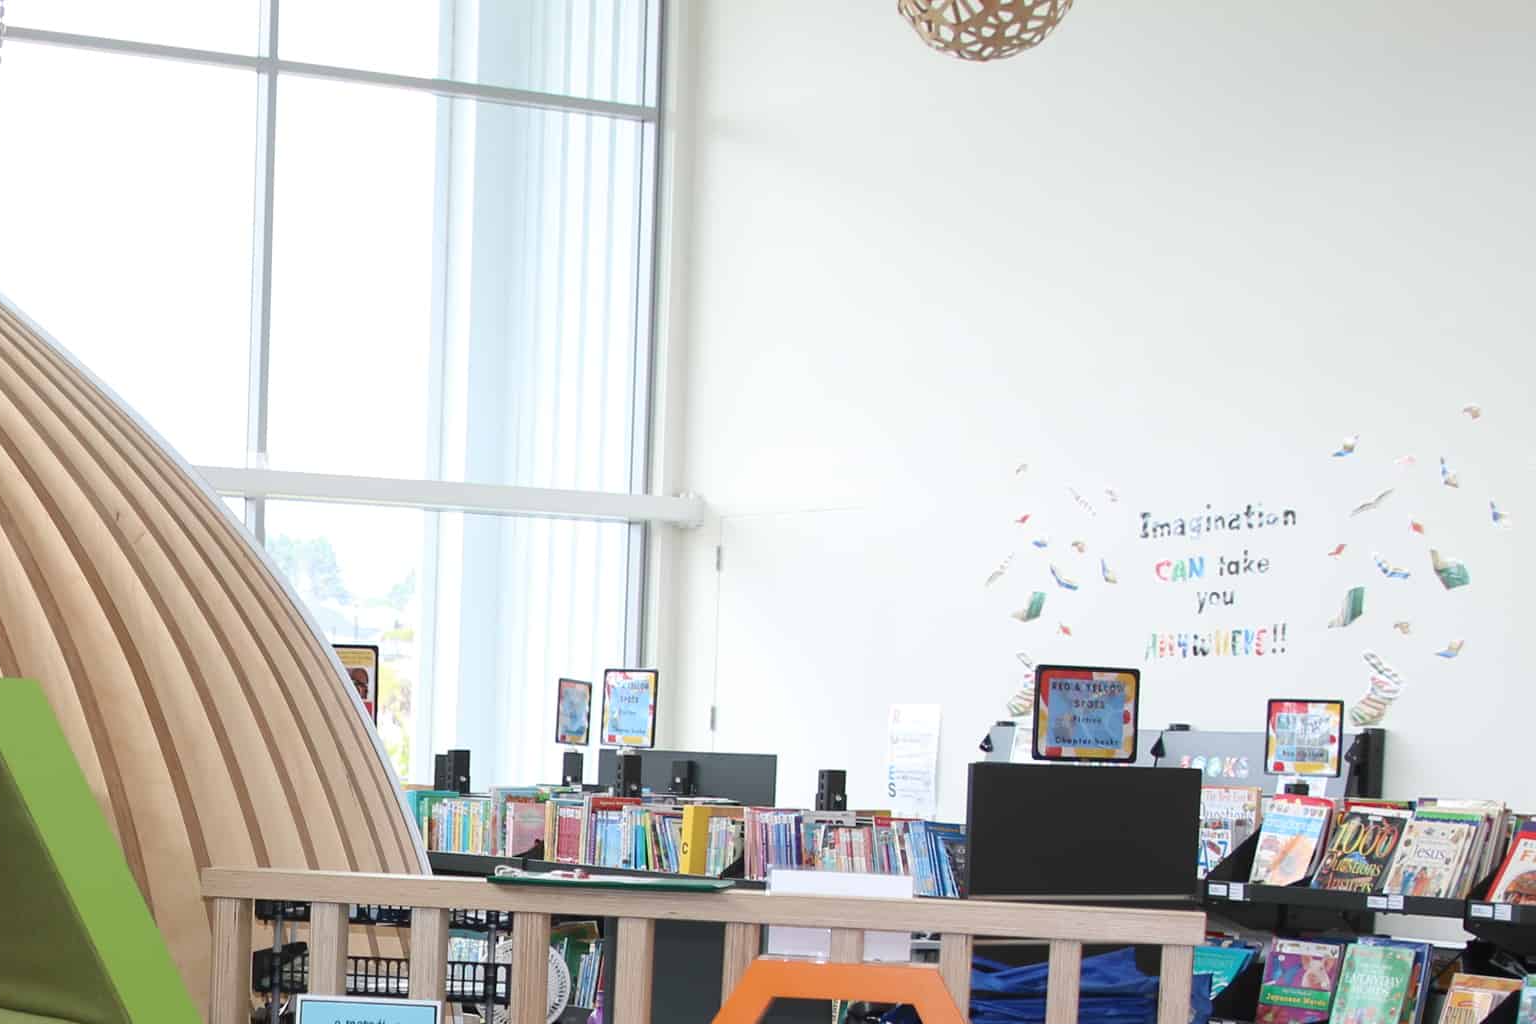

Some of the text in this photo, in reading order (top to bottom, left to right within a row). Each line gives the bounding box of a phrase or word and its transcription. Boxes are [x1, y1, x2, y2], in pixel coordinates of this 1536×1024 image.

[1139, 502, 1297, 541] Imagination
[1154, 549, 1270, 582] CAN take
[1196, 590, 1235, 614] you
[1328, 817, 1399, 858] 1000
